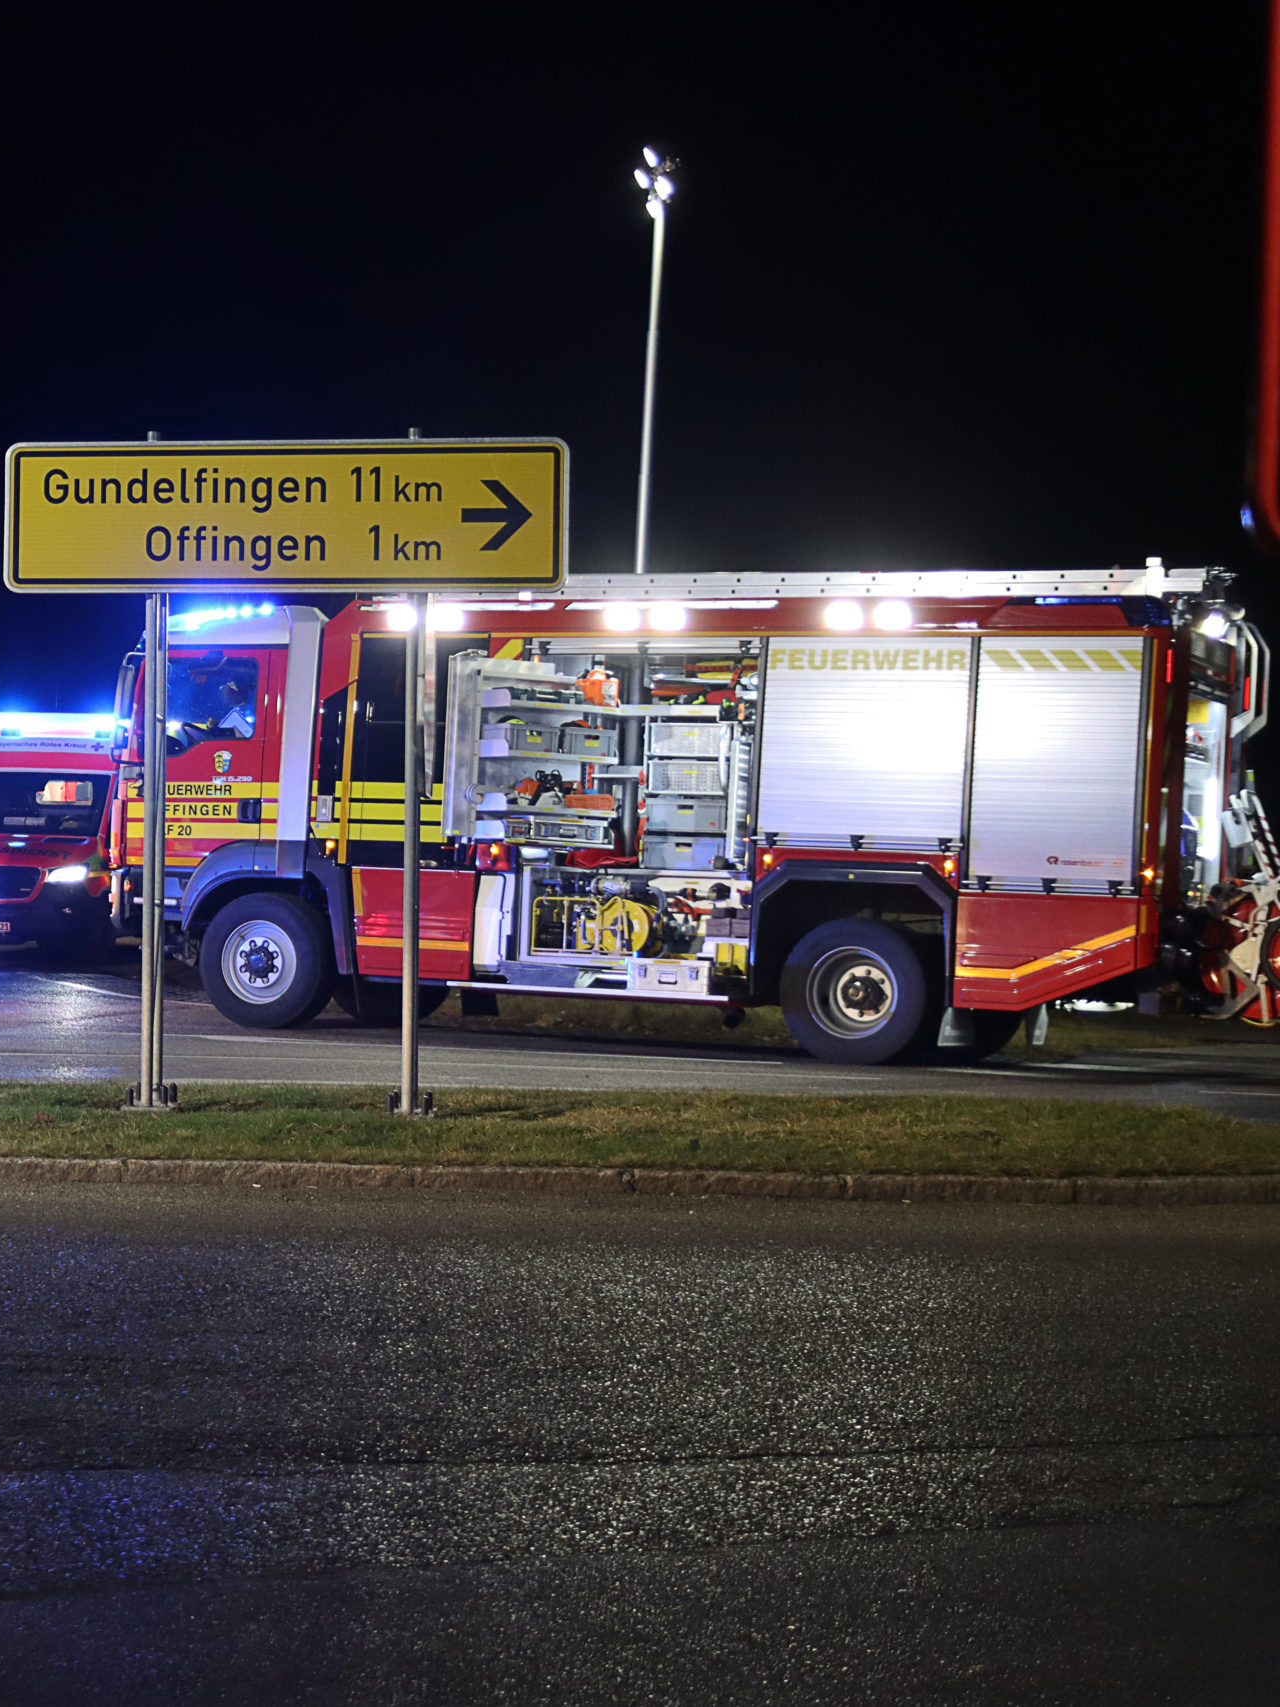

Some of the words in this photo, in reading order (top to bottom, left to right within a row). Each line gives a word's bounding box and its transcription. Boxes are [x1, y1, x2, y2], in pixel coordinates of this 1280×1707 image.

[43, 468, 327, 513] Gundelfingen
[350, 466, 381, 503] 11
[394, 475, 442, 502] km
[145, 525, 326, 571] Offingen
[368, 525, 381, 561] 1
[394, 534, 442, 561] km
[770, 648, 967, 671] FEUERWEHR
[166, 784, 232, 796] UERWEHR
[164, 804, 232, 816] FFINGEN
[177, 824, 192, 836] 20
